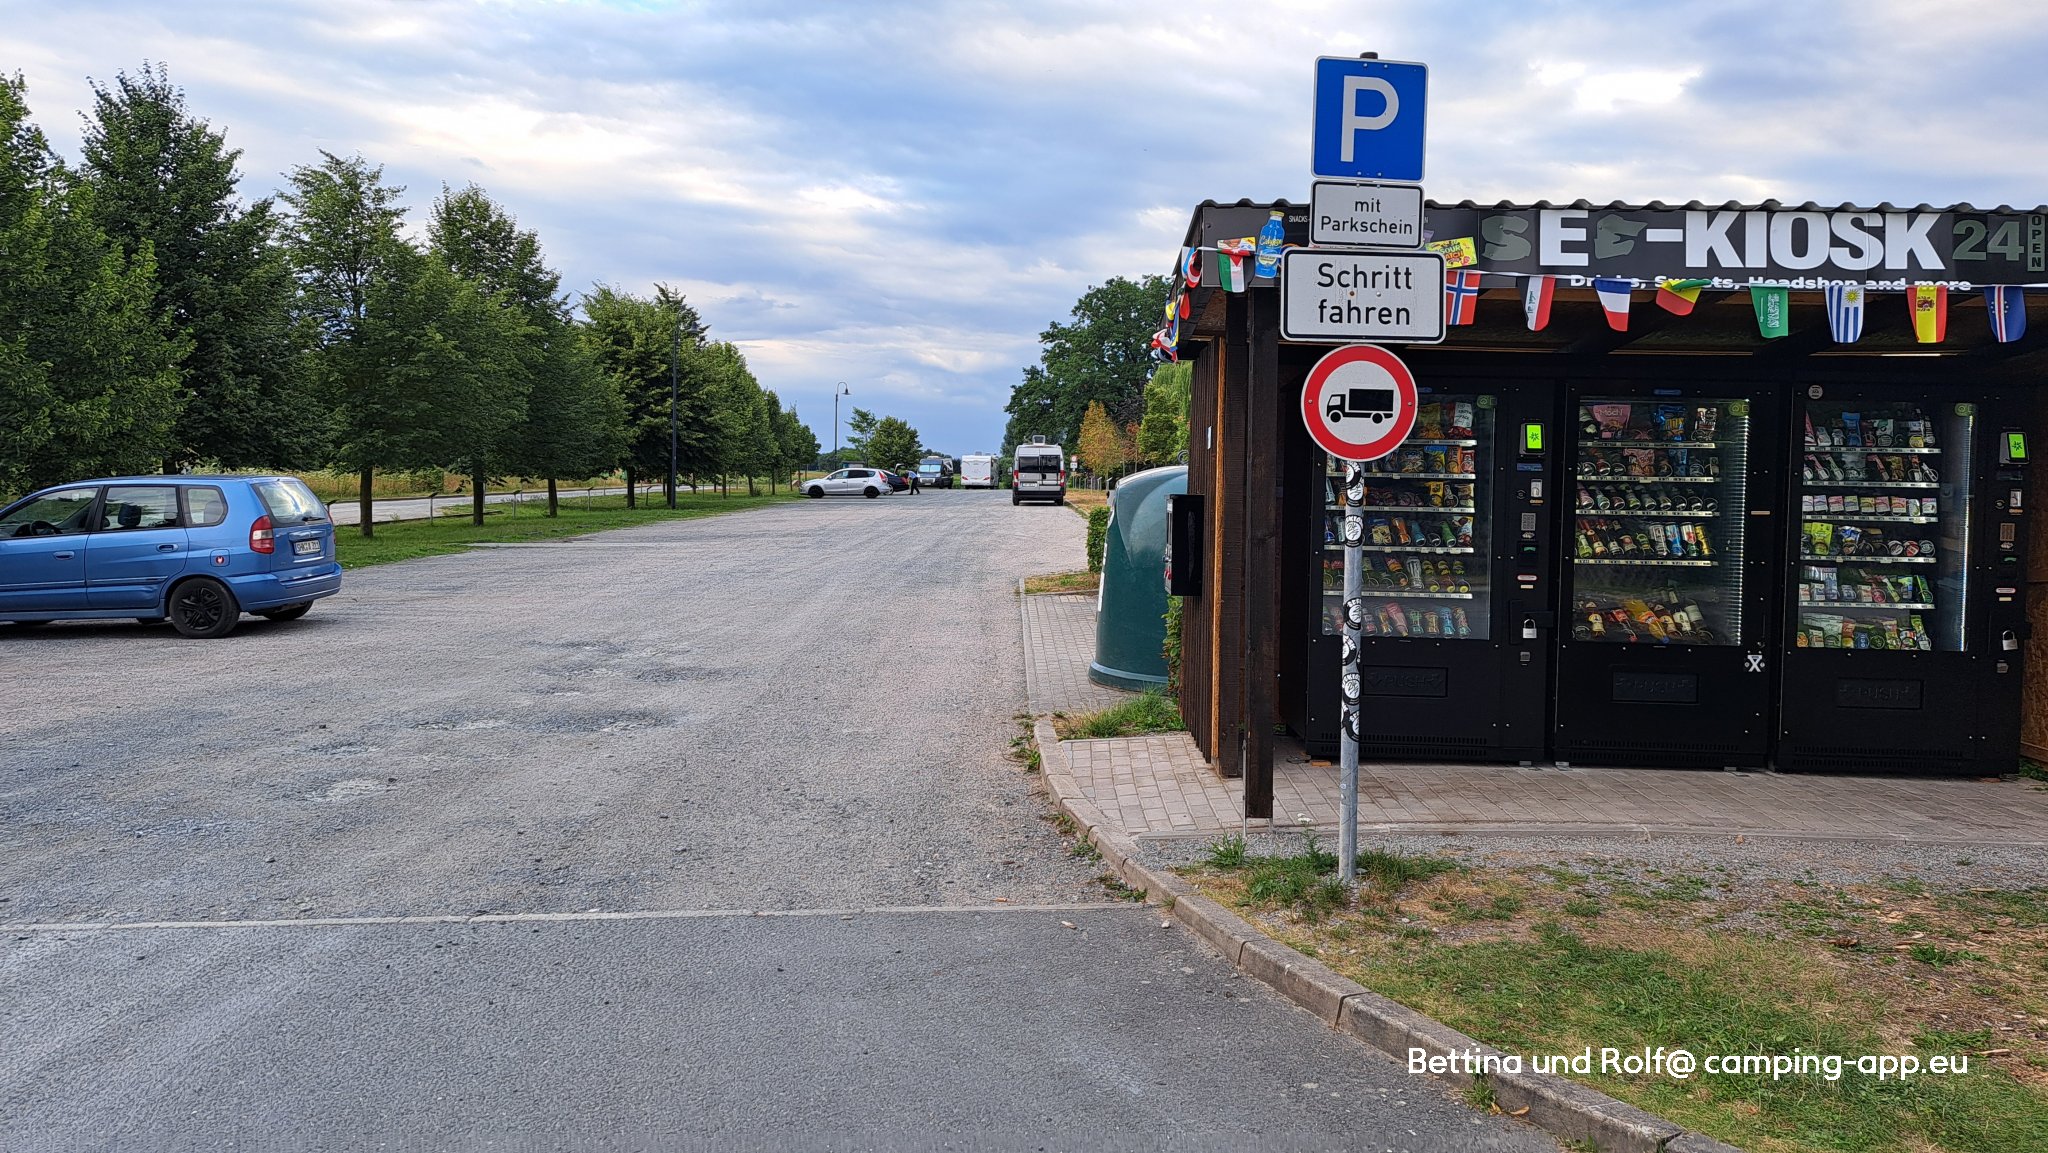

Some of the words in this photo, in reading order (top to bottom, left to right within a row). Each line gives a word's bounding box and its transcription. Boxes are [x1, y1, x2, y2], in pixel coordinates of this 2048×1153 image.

[1340, 75, 1400, 163] P
[1354, 197, 1382, 213] mit
[1320, 215, 1412, 235] Parkschein
[1952, 219, 2025, 261] 24
[2030, 214, 2043, 268] OPEN
[1444, 250, 1465, 260] ATCH
[1317, 262, 1412, 290] Schritt
[1570, 274, 1646, 289] Drs,
[1654, 275, 1740, 290] Sts,
[1865, 277, 1906, 290] and
[1914, 280, 1972, 291] more
[1318, 298, 1410, 326] fahren
